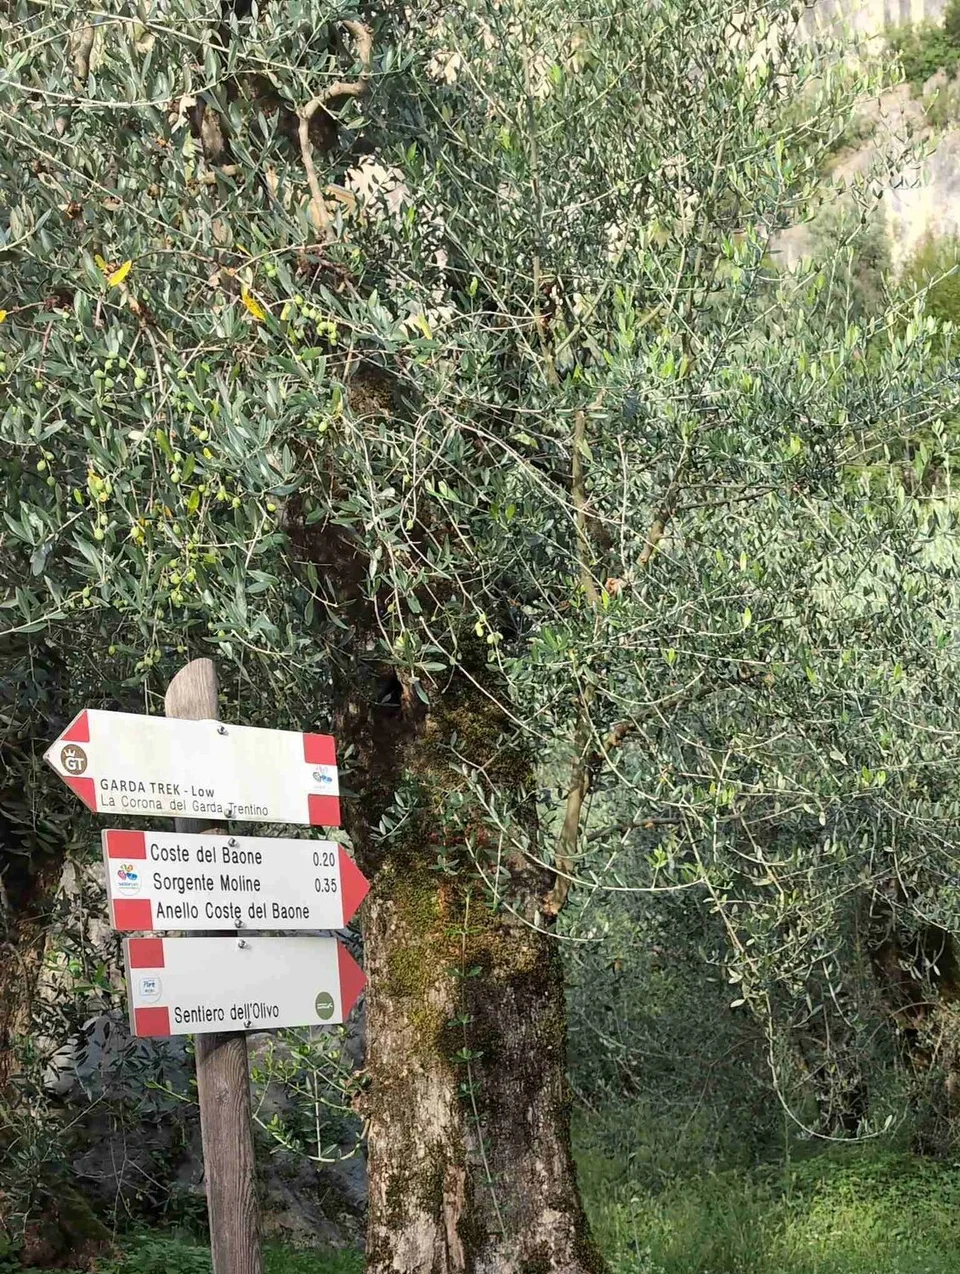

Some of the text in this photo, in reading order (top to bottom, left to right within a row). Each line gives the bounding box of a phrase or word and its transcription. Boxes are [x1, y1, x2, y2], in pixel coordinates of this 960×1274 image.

[65, 757, 84, 770] GT
[100, 779, 146, 792] GARDA
[150, 782, 180, 796] TREK
[192, 786, 214, 798] Low
[100, 794, 268, 816] La Corona del Garda Trentino
[150, 844, 336, 867] Coste del Baone 0.20
[153, 872, 338, 894] Sorgente Moline 0.35
[156, 902, 310, 919] Anello Coste del Baone
[174, 1002, 279, 1024] Sentiero dell'Olivo
